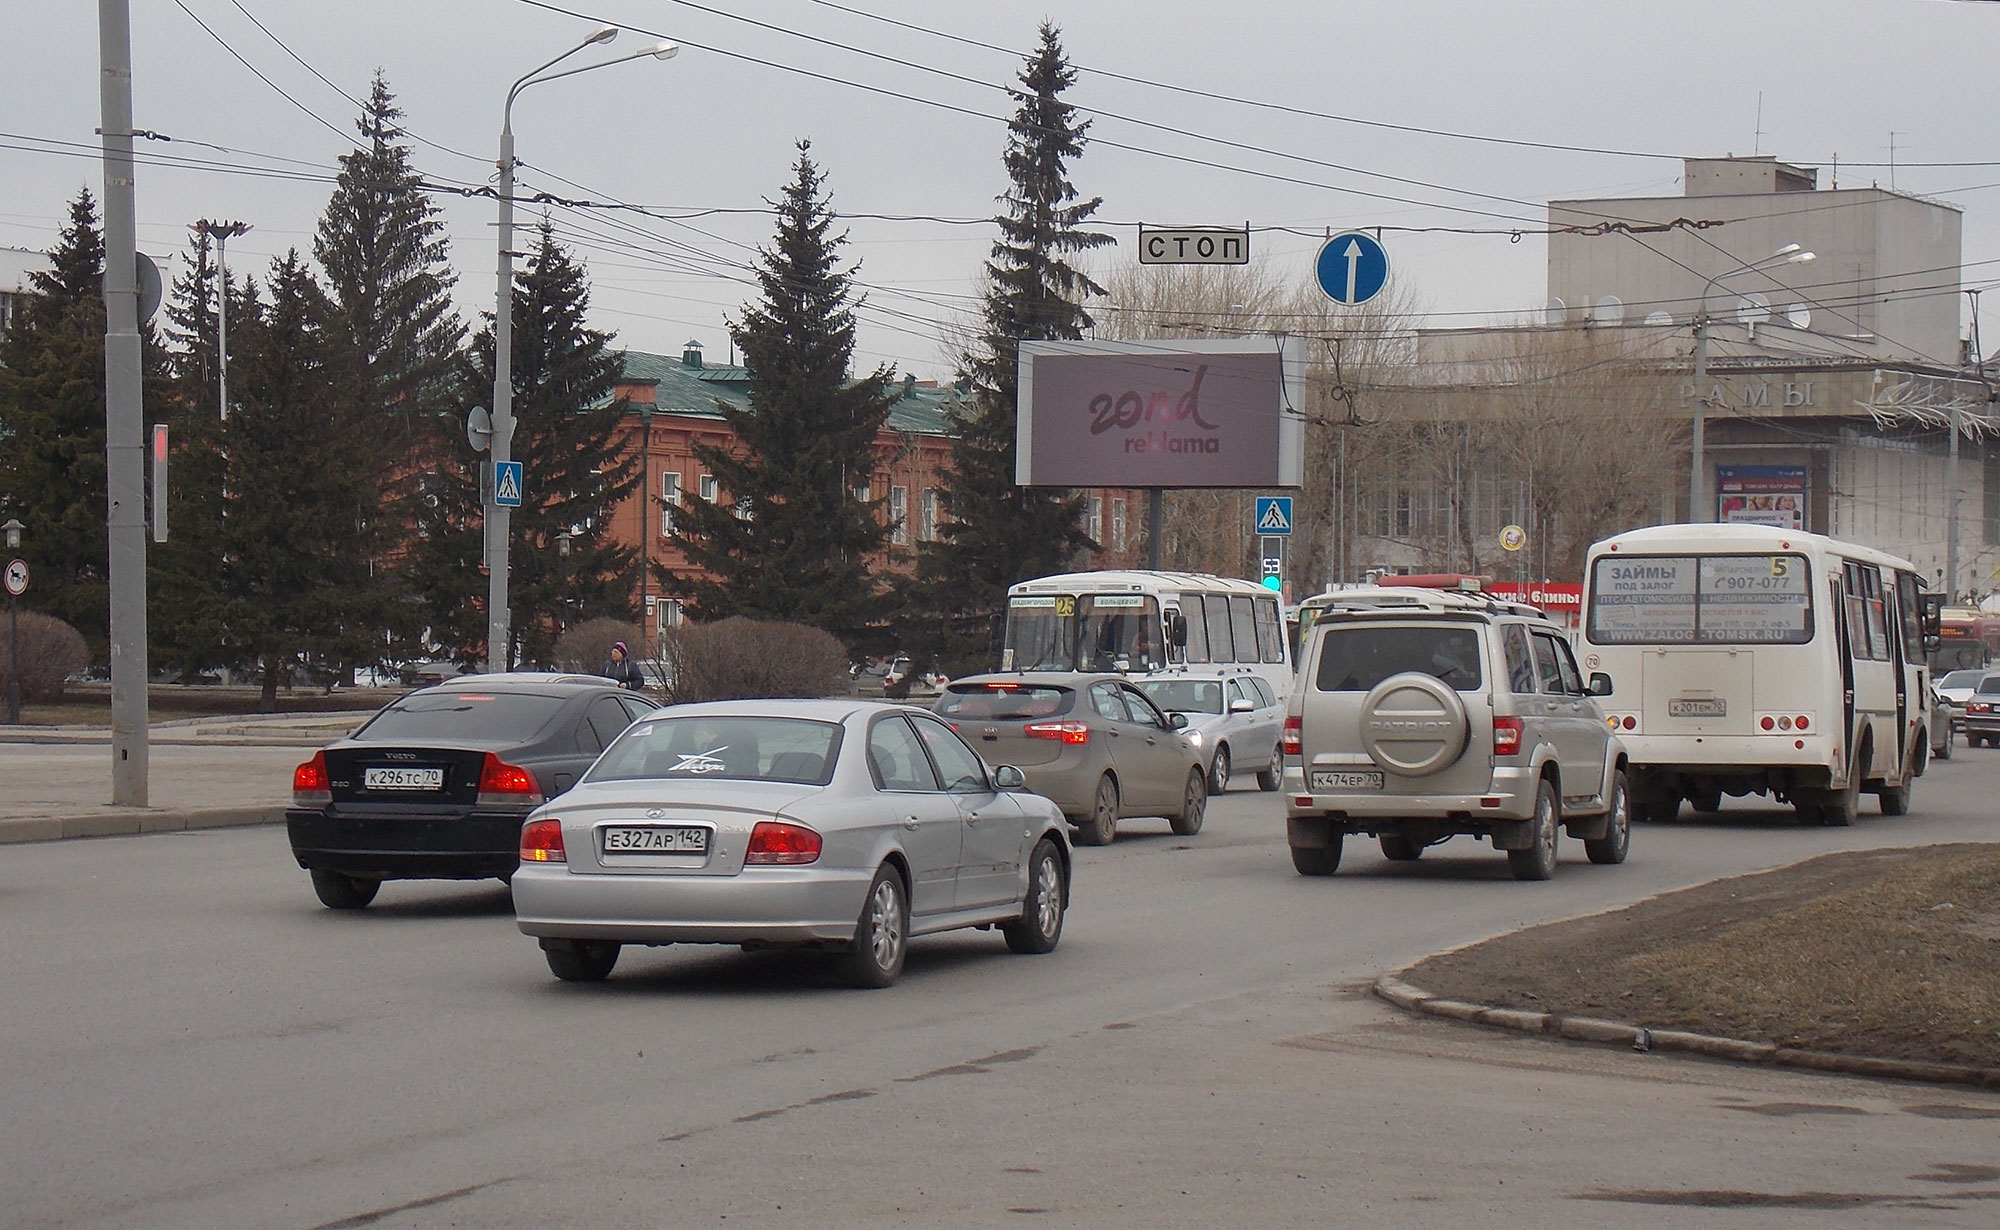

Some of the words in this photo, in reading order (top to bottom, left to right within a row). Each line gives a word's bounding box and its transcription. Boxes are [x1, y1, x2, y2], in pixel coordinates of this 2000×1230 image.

[1147, 236, 1241, 258] СТОП
[1124, 432, 1220, 454] reklama
[1263, 558, 1280, 574] 53
[1611, 564, 1677, 579] ЗАЙМЫ
[1773, 558, 1788, 577] 5
[1614, 582, 1637, 591] ПОД
[1640, 582, 1675, 591] ЗАЛОГ
[1727, 577, 1790, 589] 907-077
[1531, 590, 1580, 604] блины
[1624, 594, 1694, 604] АВТОМОБИЛЯ
[1709, 594, 1799, 603] НЕДВИЖИМОСТИ
[1057, 598, 1074, 615] 25
[1588, 657, 1599, 667] 70
[1369, 721, 1452, 733] PATRIOT
[385, 752, 417, 760] VOLVO
[678, 830, 702, 844] 142
